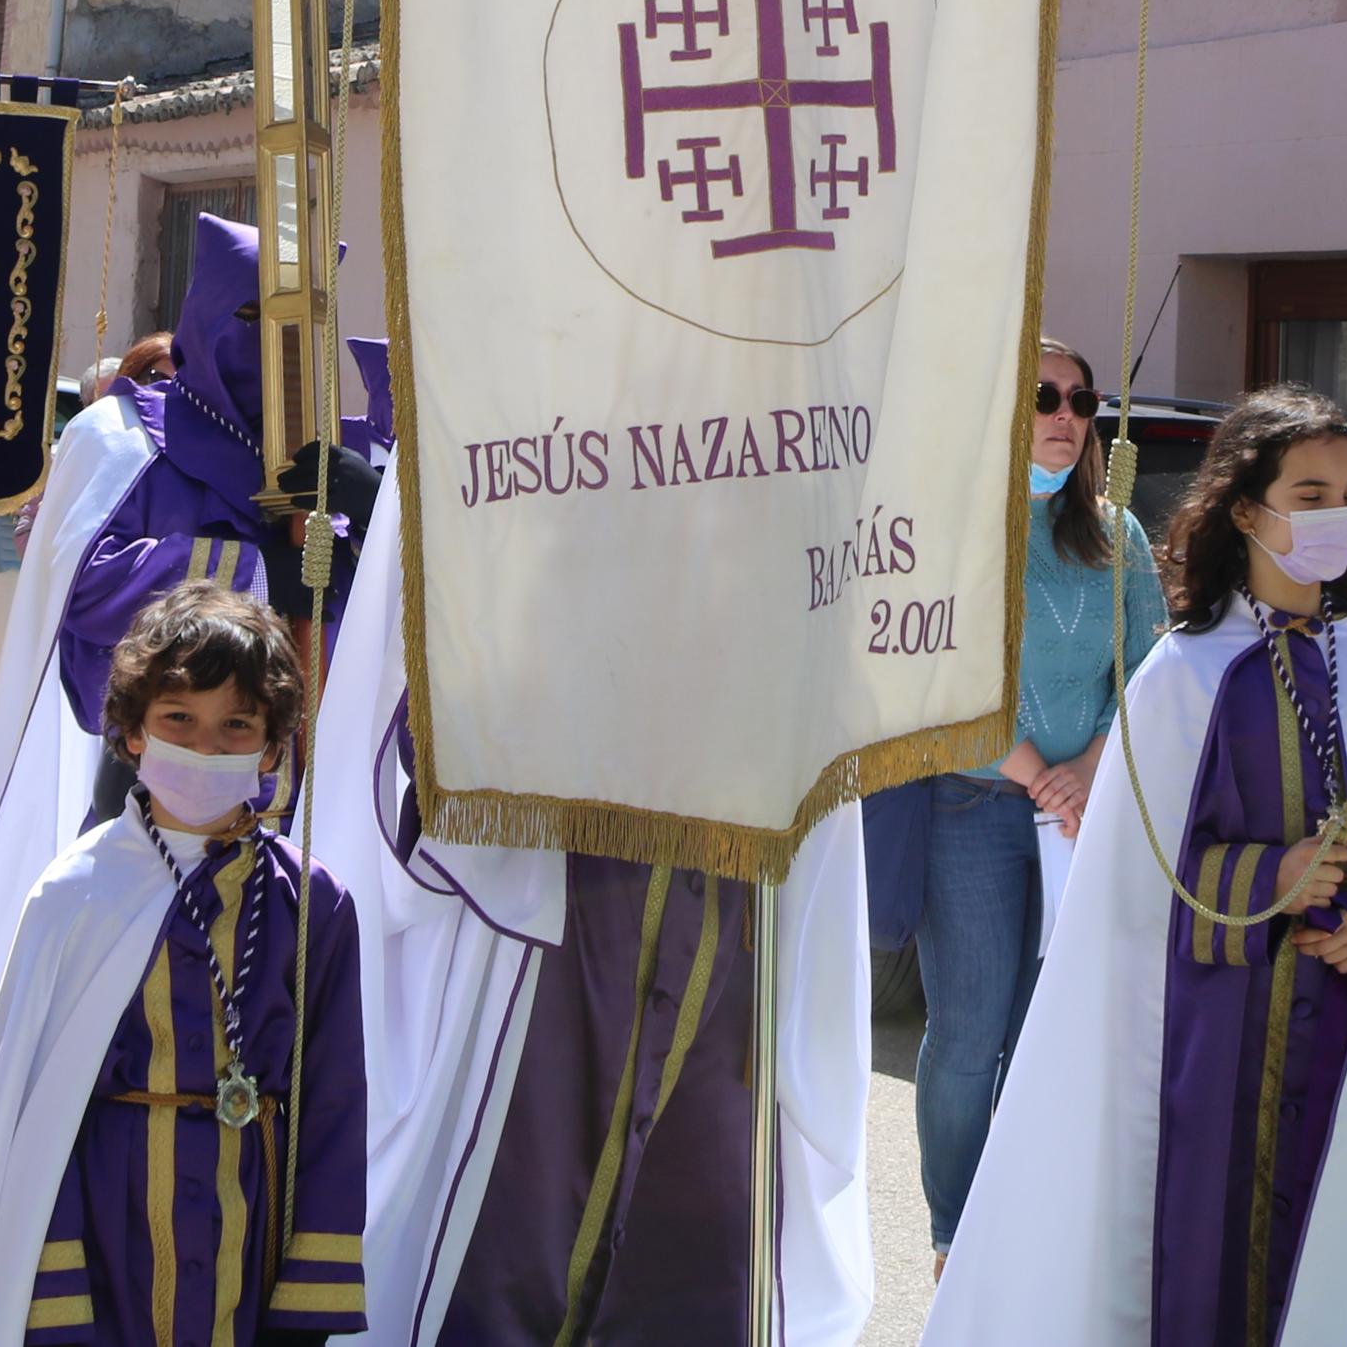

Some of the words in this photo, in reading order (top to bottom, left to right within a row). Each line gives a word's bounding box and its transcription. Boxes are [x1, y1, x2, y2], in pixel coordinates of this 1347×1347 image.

[461, 416, 610, 508] JESÚS
[627, 405, 871, 490] NAZARENO
[868, 595, 957, 655] 2.001
